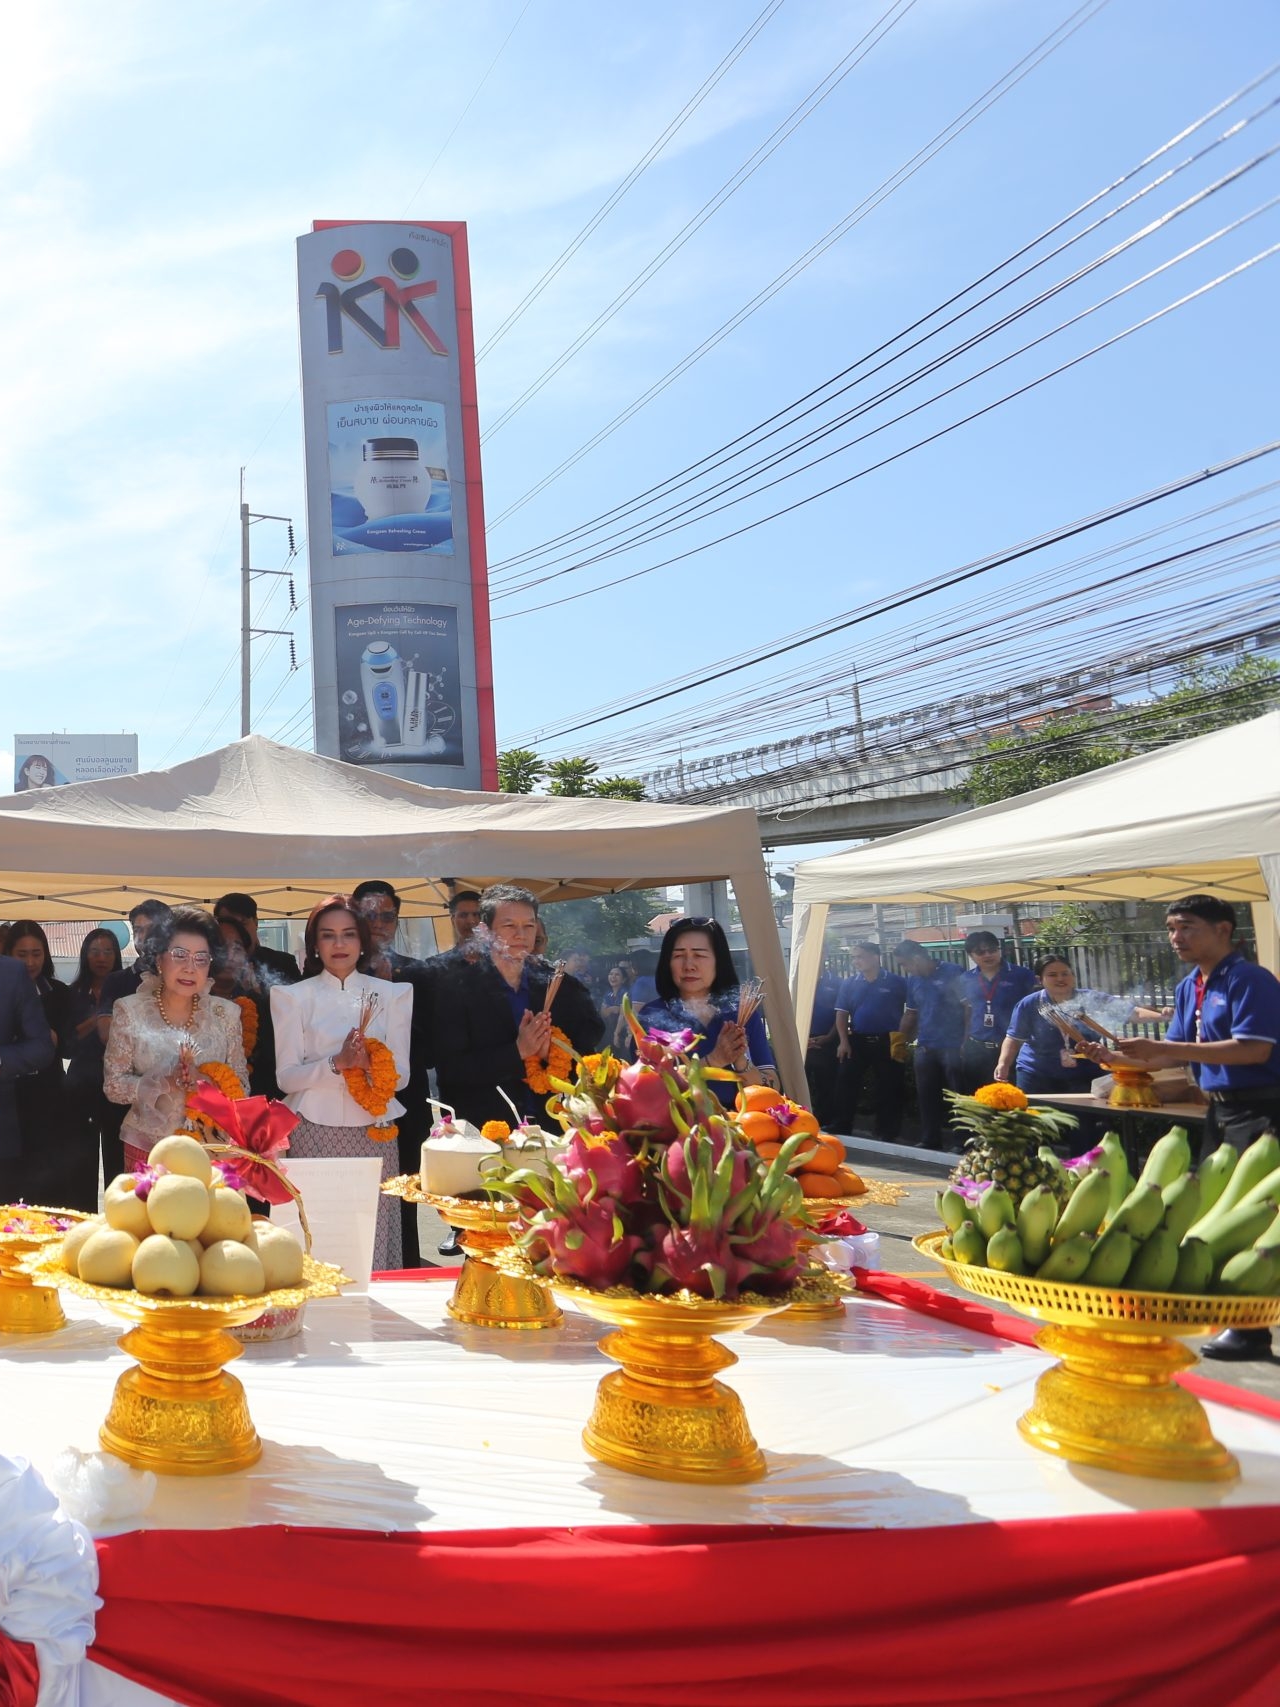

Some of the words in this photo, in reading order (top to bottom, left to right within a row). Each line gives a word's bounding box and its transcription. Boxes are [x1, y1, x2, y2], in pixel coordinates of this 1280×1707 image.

[337, 416, 379, 428] เย็นสบาย
[382, 413, 438, 429] ผ่อนคลายผิว
[403, 615, 448, 628] Technology
